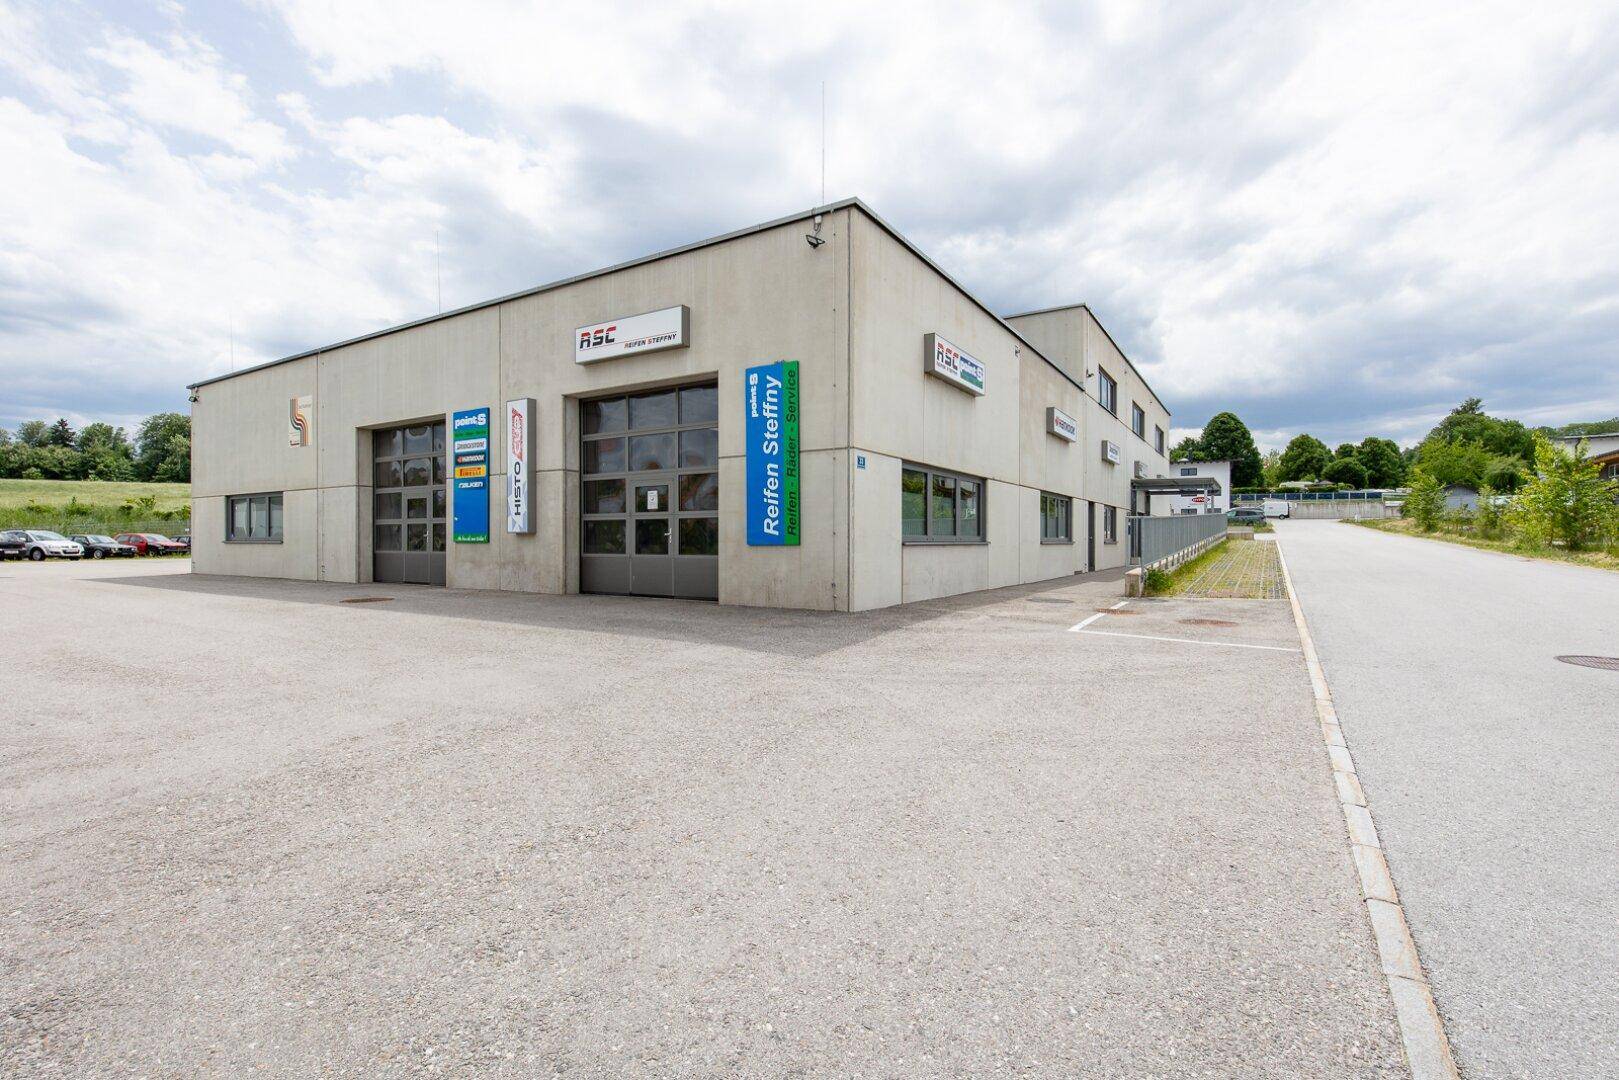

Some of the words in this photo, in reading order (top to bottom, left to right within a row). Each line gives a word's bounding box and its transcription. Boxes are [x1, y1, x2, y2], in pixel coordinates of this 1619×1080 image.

[580, 326, 616, 349] RSC
[624, 339, 646, 349] REIFEN
[647, 334, 677, 345] STEFFNY
[763, 375, 782, 456] Steffny
[786, 370, 797, 424] Service
[786, 436, 797, 478] Räder
[763, 463, 779, 536] Reifen
[787, 491, 797, 536] Reifen
